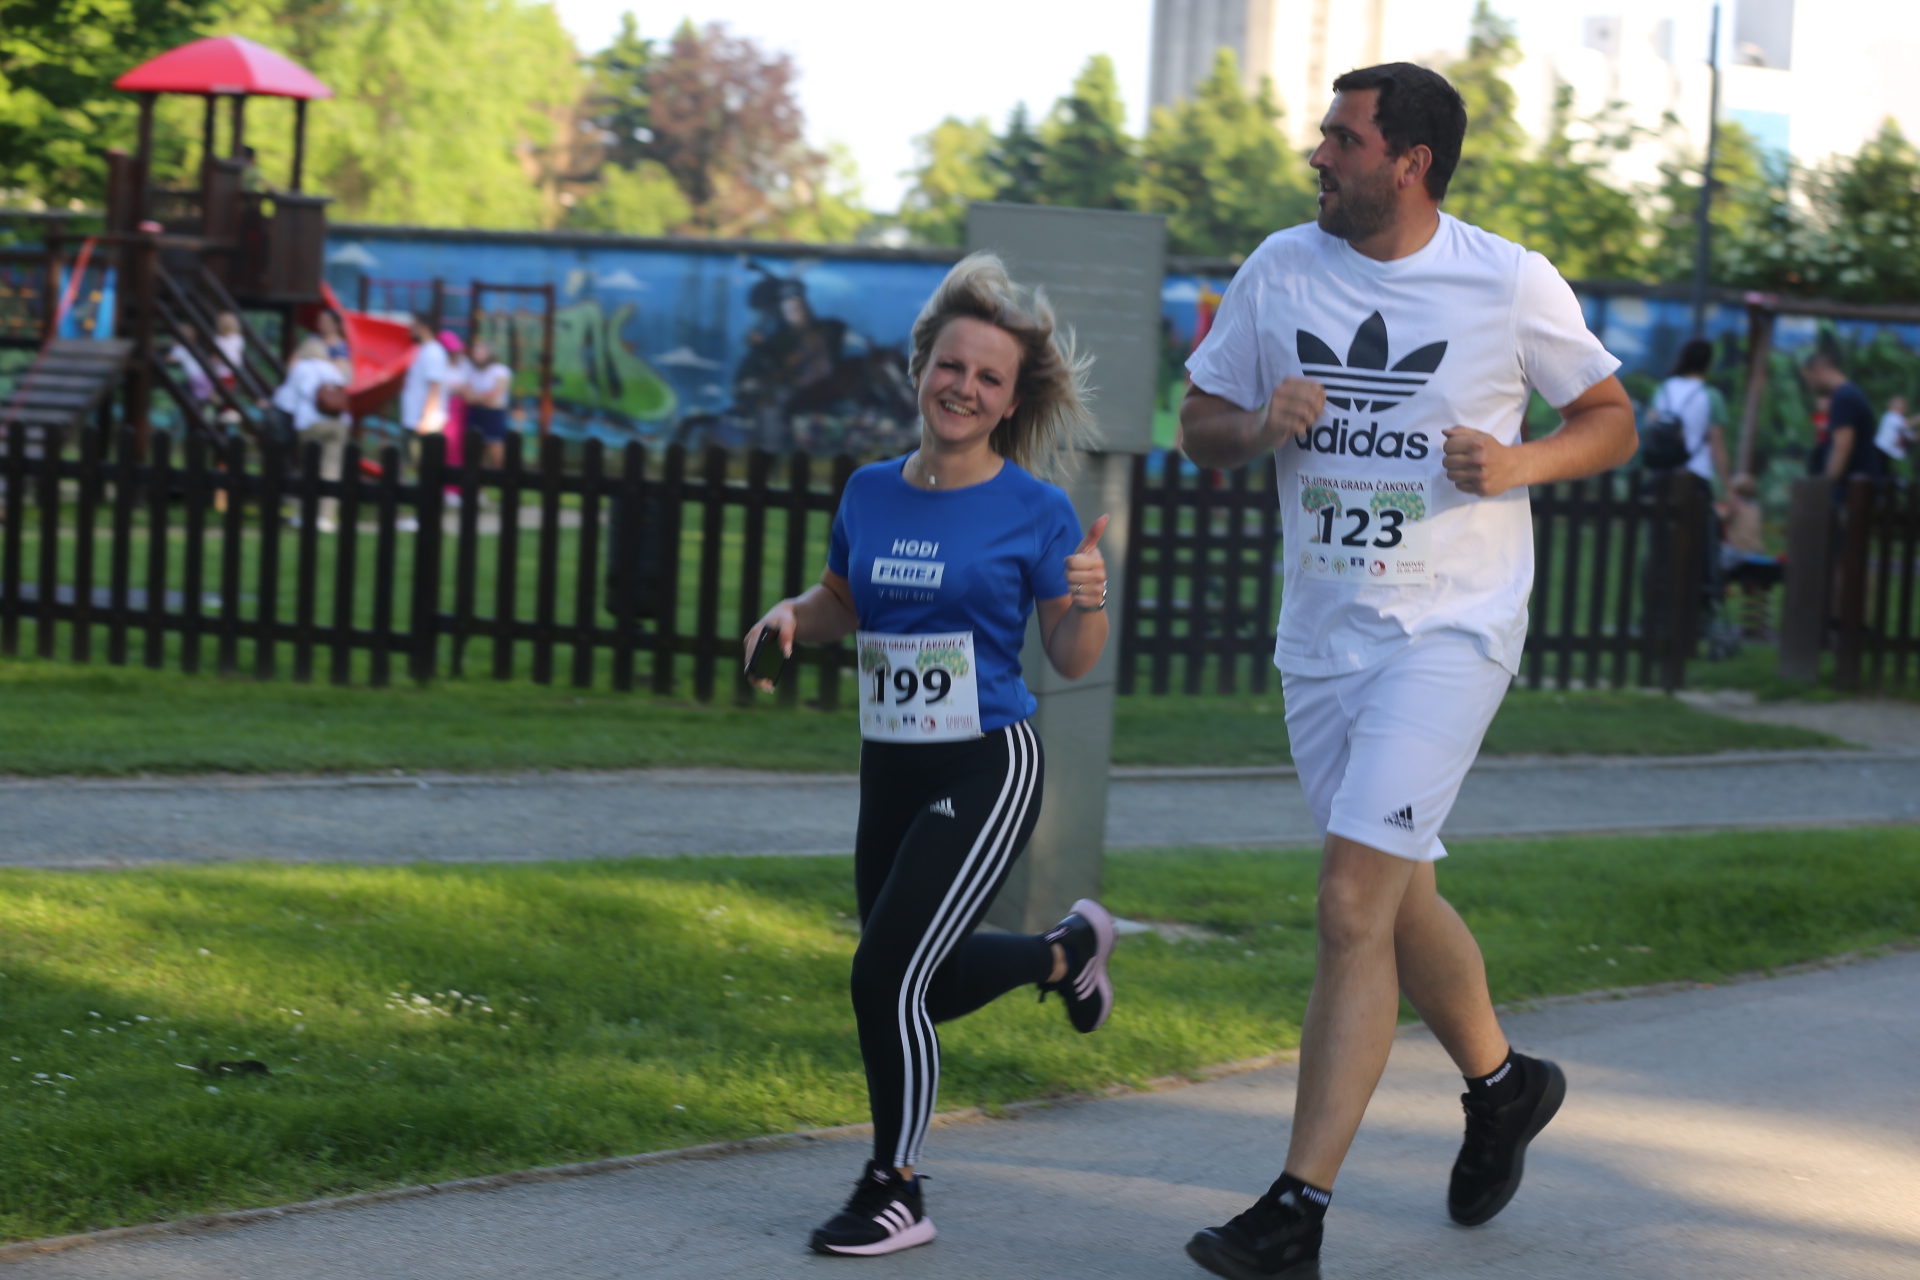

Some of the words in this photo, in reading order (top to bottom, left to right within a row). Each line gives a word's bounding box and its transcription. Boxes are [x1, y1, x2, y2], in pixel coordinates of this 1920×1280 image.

[1294, 418, 1429, 460] adidas
[1313, 476, 1339, 489] UTRKA
[1340, 479, 1374, 492] GRADA
[1376, 478, 1425, 493] ČAKOVCA
[1320, 504, 1404, 549] 123
[891, 538, 940, 559] HODI
[874, 665, 952, 708] 199
[1485, 1062, 1512, 1087] PUMA
